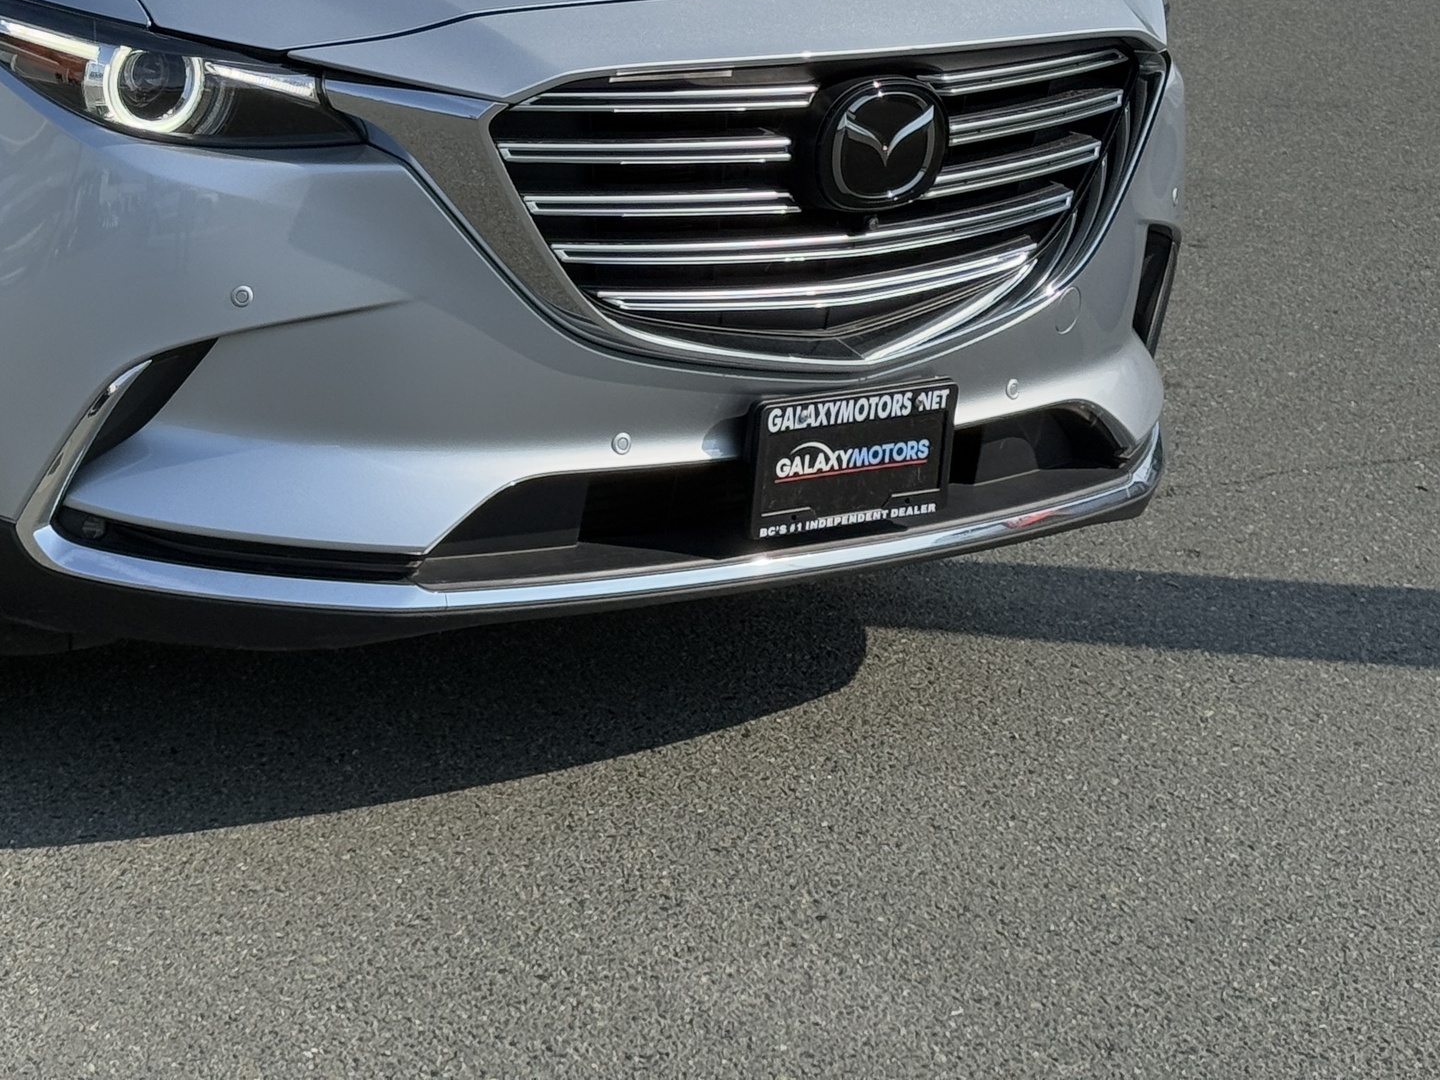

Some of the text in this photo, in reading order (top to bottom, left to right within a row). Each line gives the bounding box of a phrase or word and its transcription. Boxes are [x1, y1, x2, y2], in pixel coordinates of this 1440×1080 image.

[776, 439, 929, 478] GALAXYMOTORS
[759, 523, 788, 538] BC'S
[805, 510, 890, 531] INDEPENDENT
[890, 503, 936, 519] DEALER
